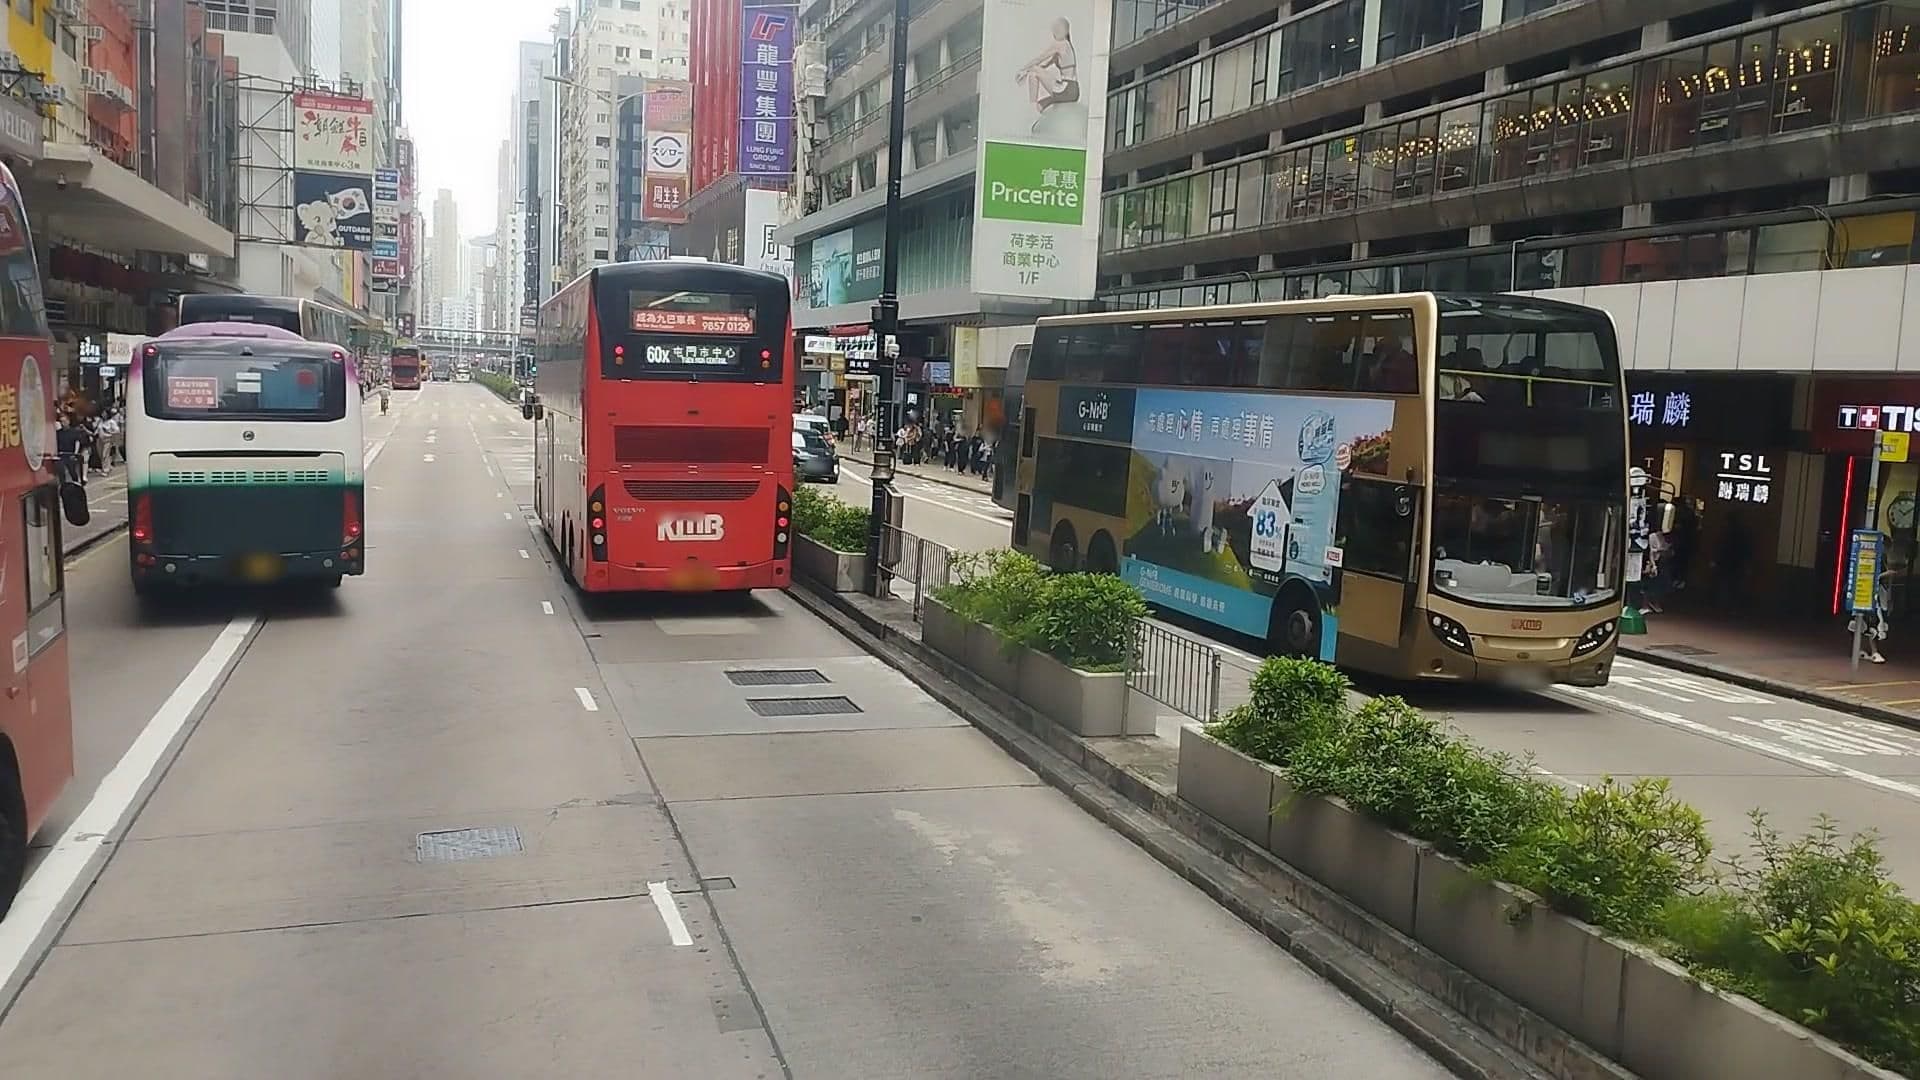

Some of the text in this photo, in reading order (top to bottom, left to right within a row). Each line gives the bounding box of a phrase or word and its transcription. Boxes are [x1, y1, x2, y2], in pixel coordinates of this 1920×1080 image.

[755, 44, 779, 143] 龍豐集團
[651, 147, 684, 156] スシロー
[746, 145, 784, 156] LUNG FUNG
[752, 153, 777, 162] GROUP
[1041, 168, 1078, 190] 實惠
[991, 181, 1078, 208] Pricerite
[1010, 232, 1054, 250] 荷李活
[1002, 251, 1060, 269] 商業中心
[1018, 271, 1040, 285] 1/F
[636, 313, 696, 325] 成為九巴車長
[702, 321, 750, 331] 9857 0129
[673, 345, 736, 359] 屯門市中心
[1211, 408, 1274, 449] 再處理事情
[1720, 453, 1770, 473] TSL
[1718, 481, 1770, 503] 謝瑞麟
